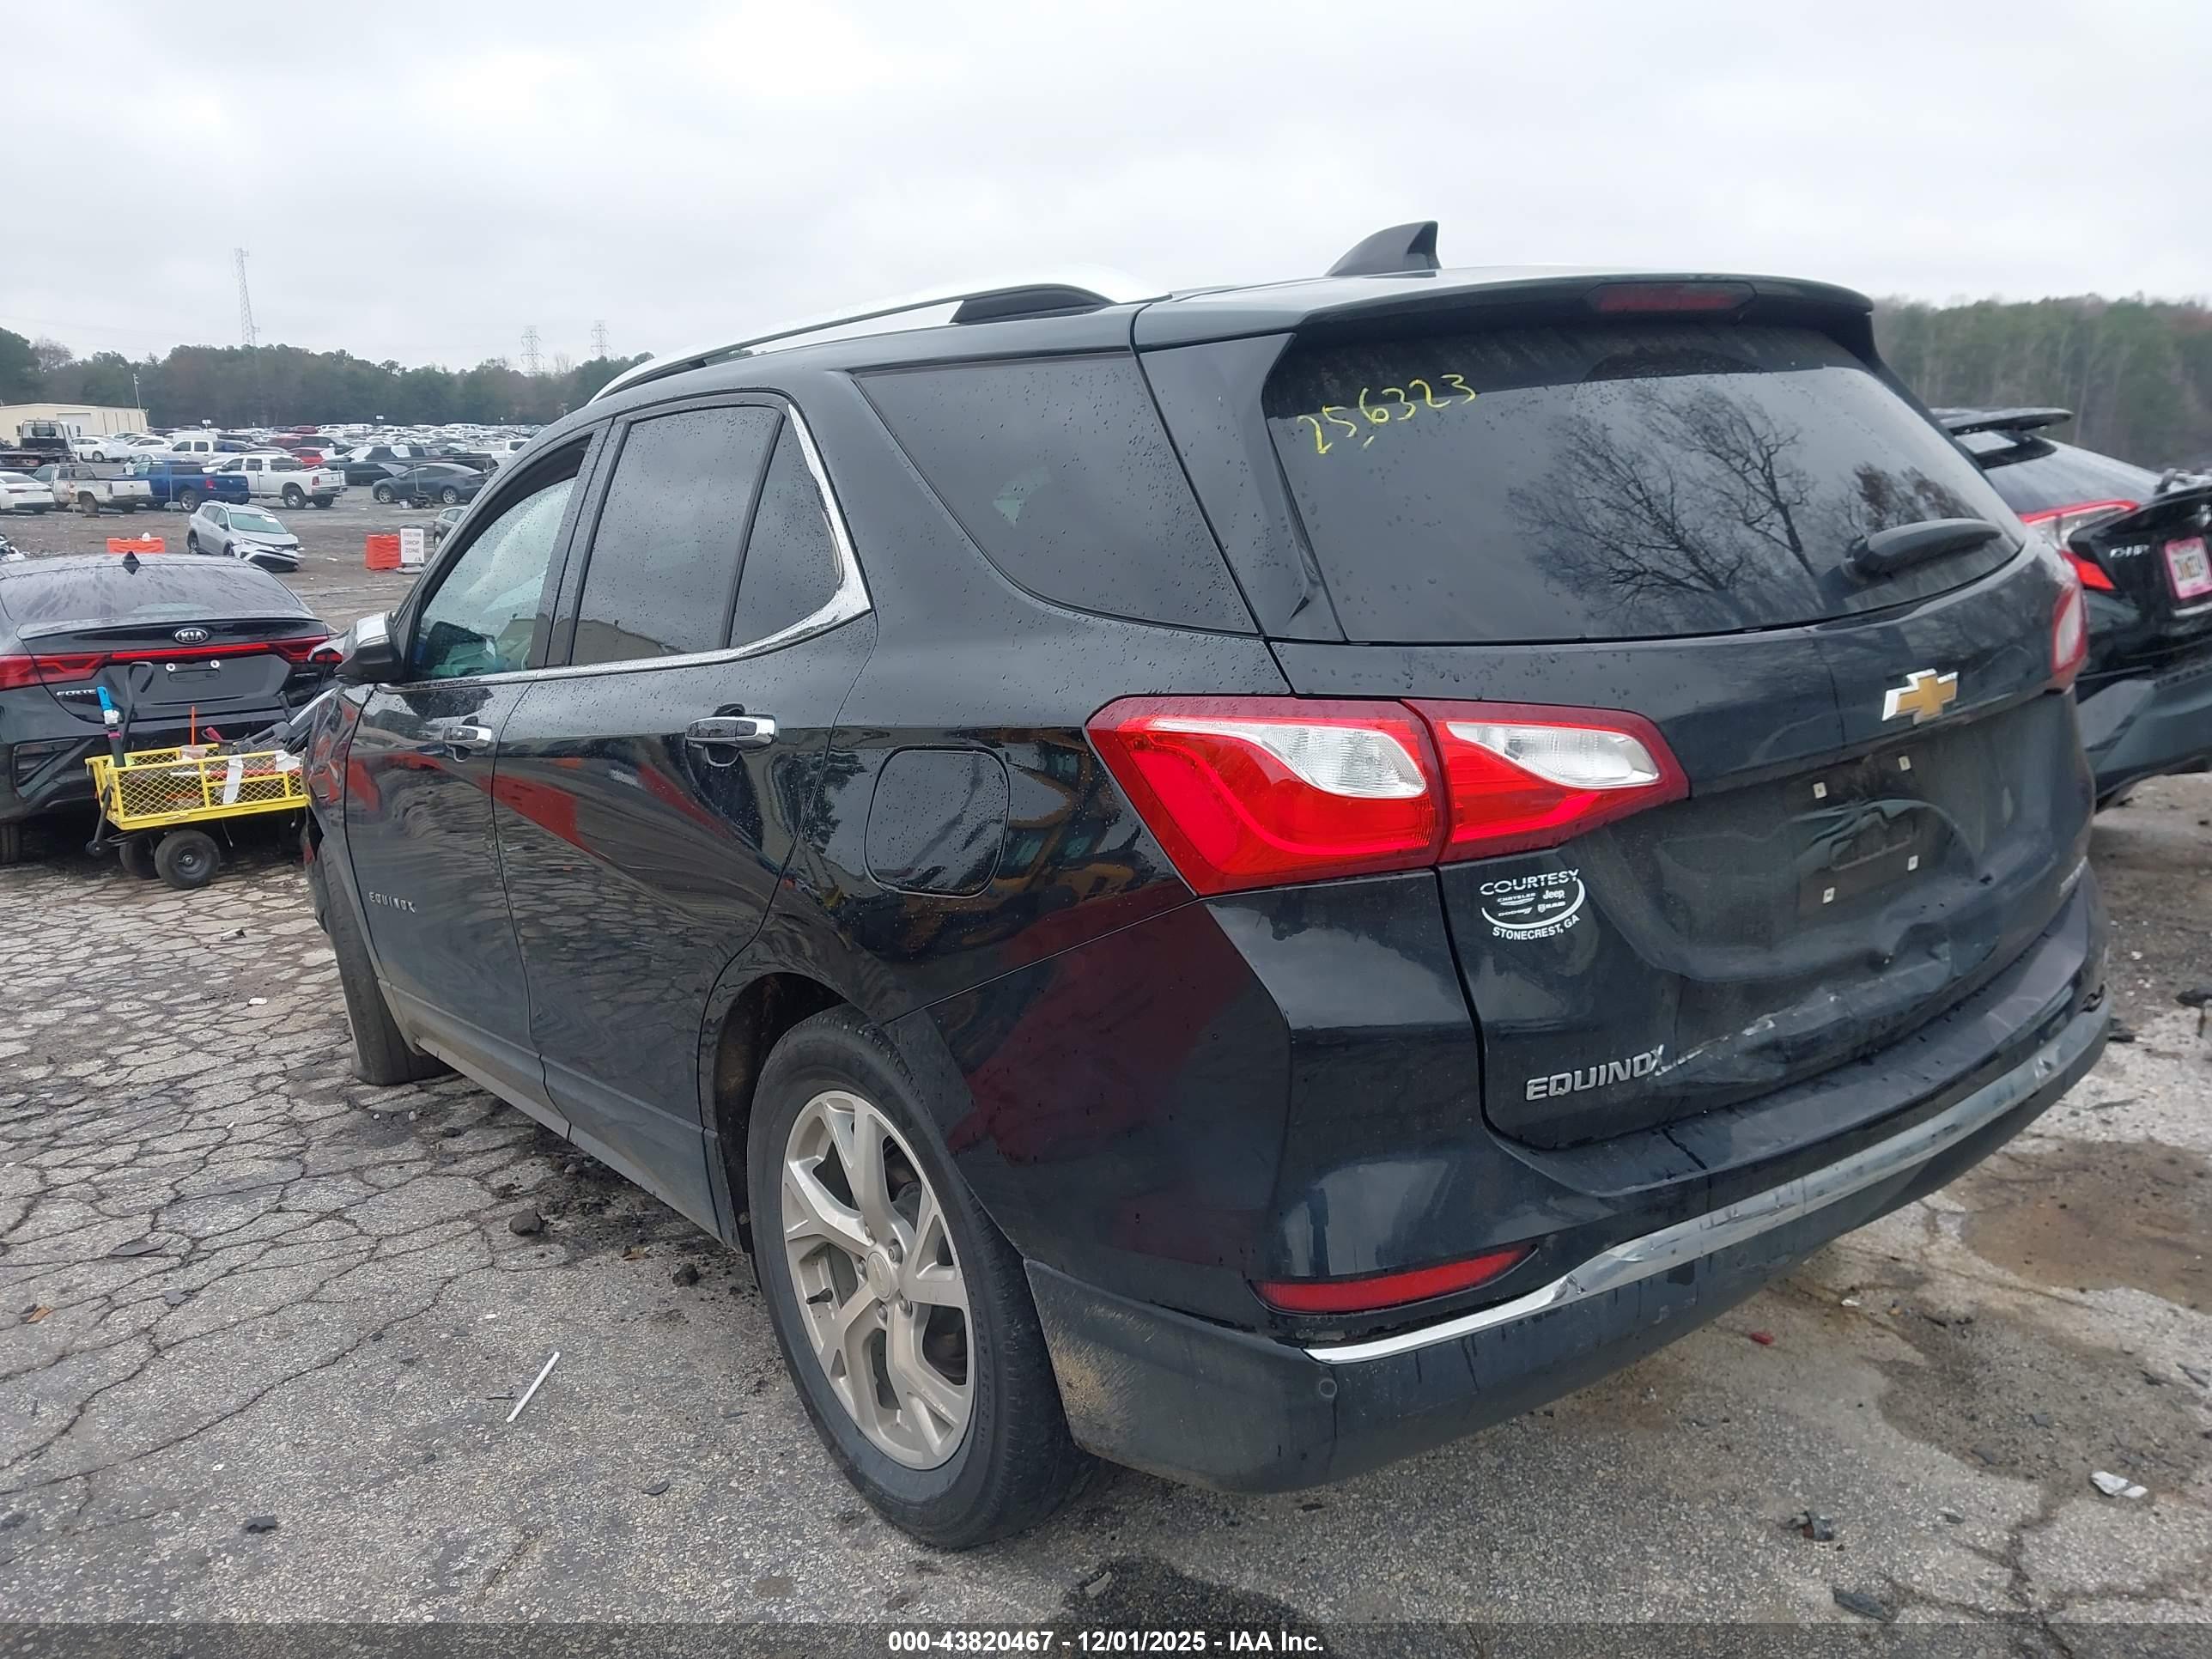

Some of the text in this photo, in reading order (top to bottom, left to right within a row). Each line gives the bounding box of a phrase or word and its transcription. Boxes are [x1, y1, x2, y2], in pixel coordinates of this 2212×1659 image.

[1480, 868, 1579, 895] COURTESY
[368, 891, 416, 913] EQUINOX
[1497, 892, 1536, 902] CHRYSLER
[1492, 914, 1580, 940] STONECREST, GA
[1526, 1043, 1664, 1101] EQUINOX
